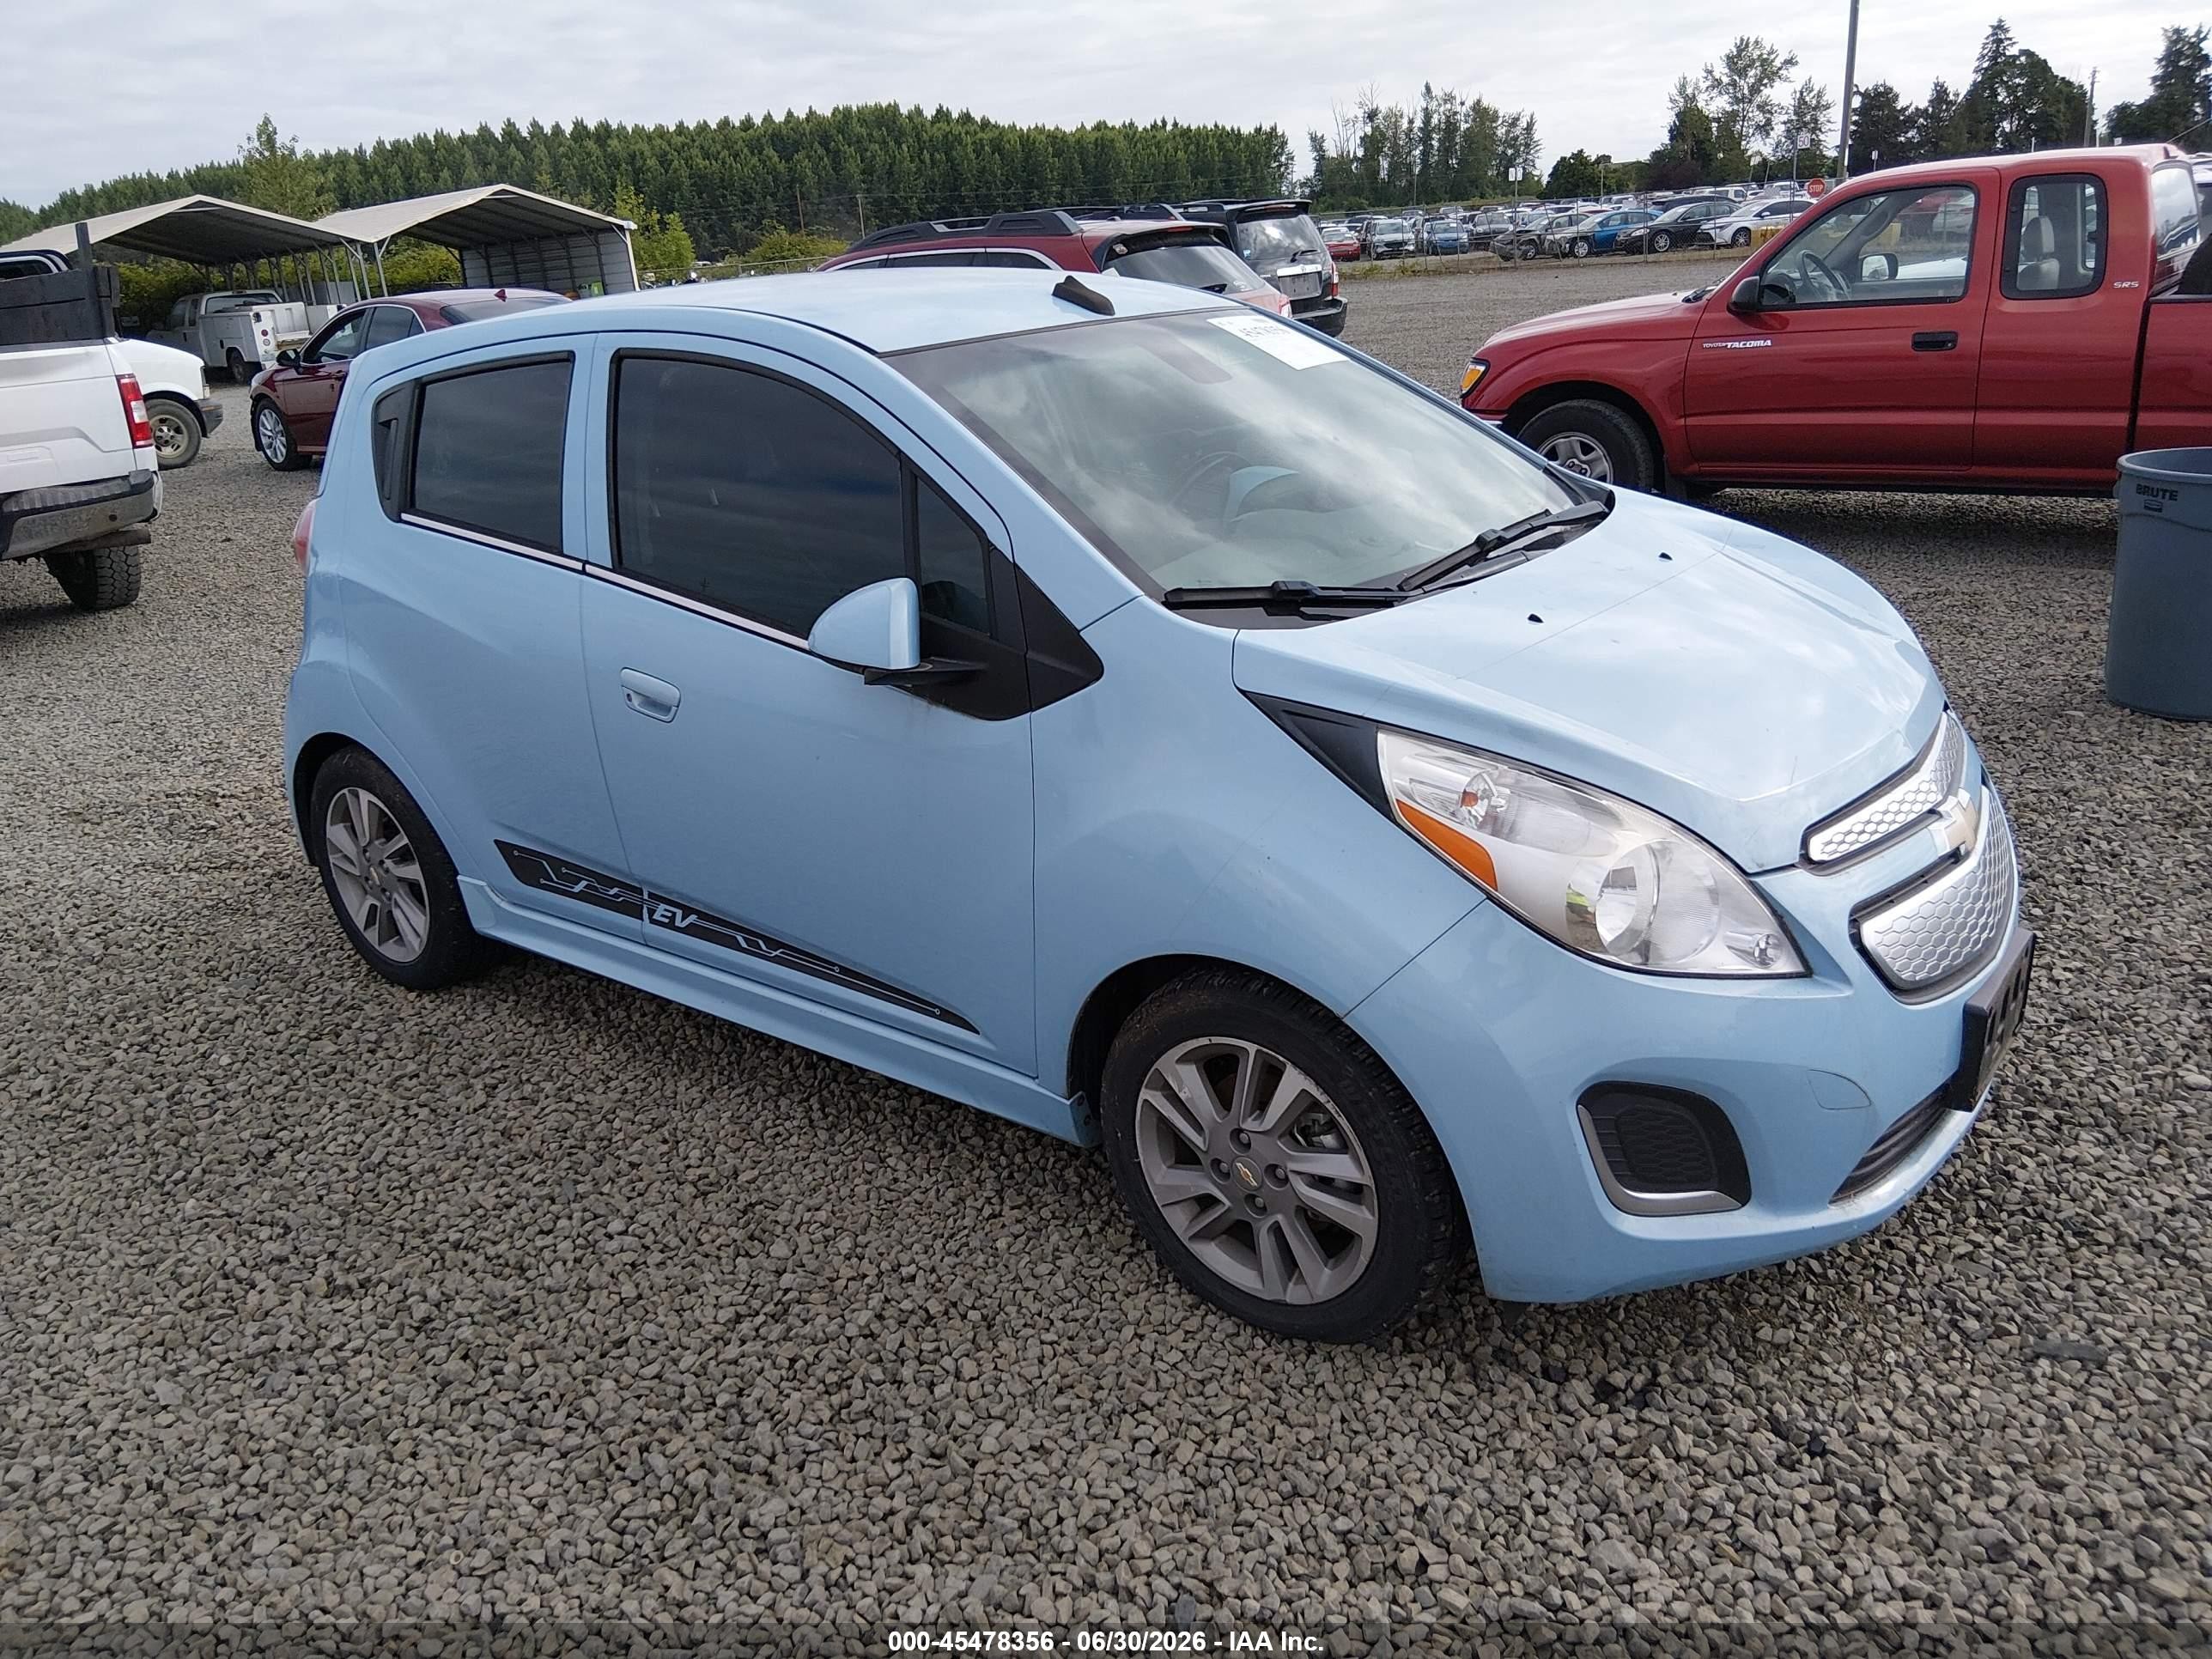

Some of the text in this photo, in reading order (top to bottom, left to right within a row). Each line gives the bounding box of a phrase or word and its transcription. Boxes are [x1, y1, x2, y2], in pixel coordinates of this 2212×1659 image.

[1809, 185, 1824, 193] STOP
[1725, 340, 1772, 349] TACOMA
[2136, 483, 2179, 501] BRUTE
[653, 903, 698, 927] EV
